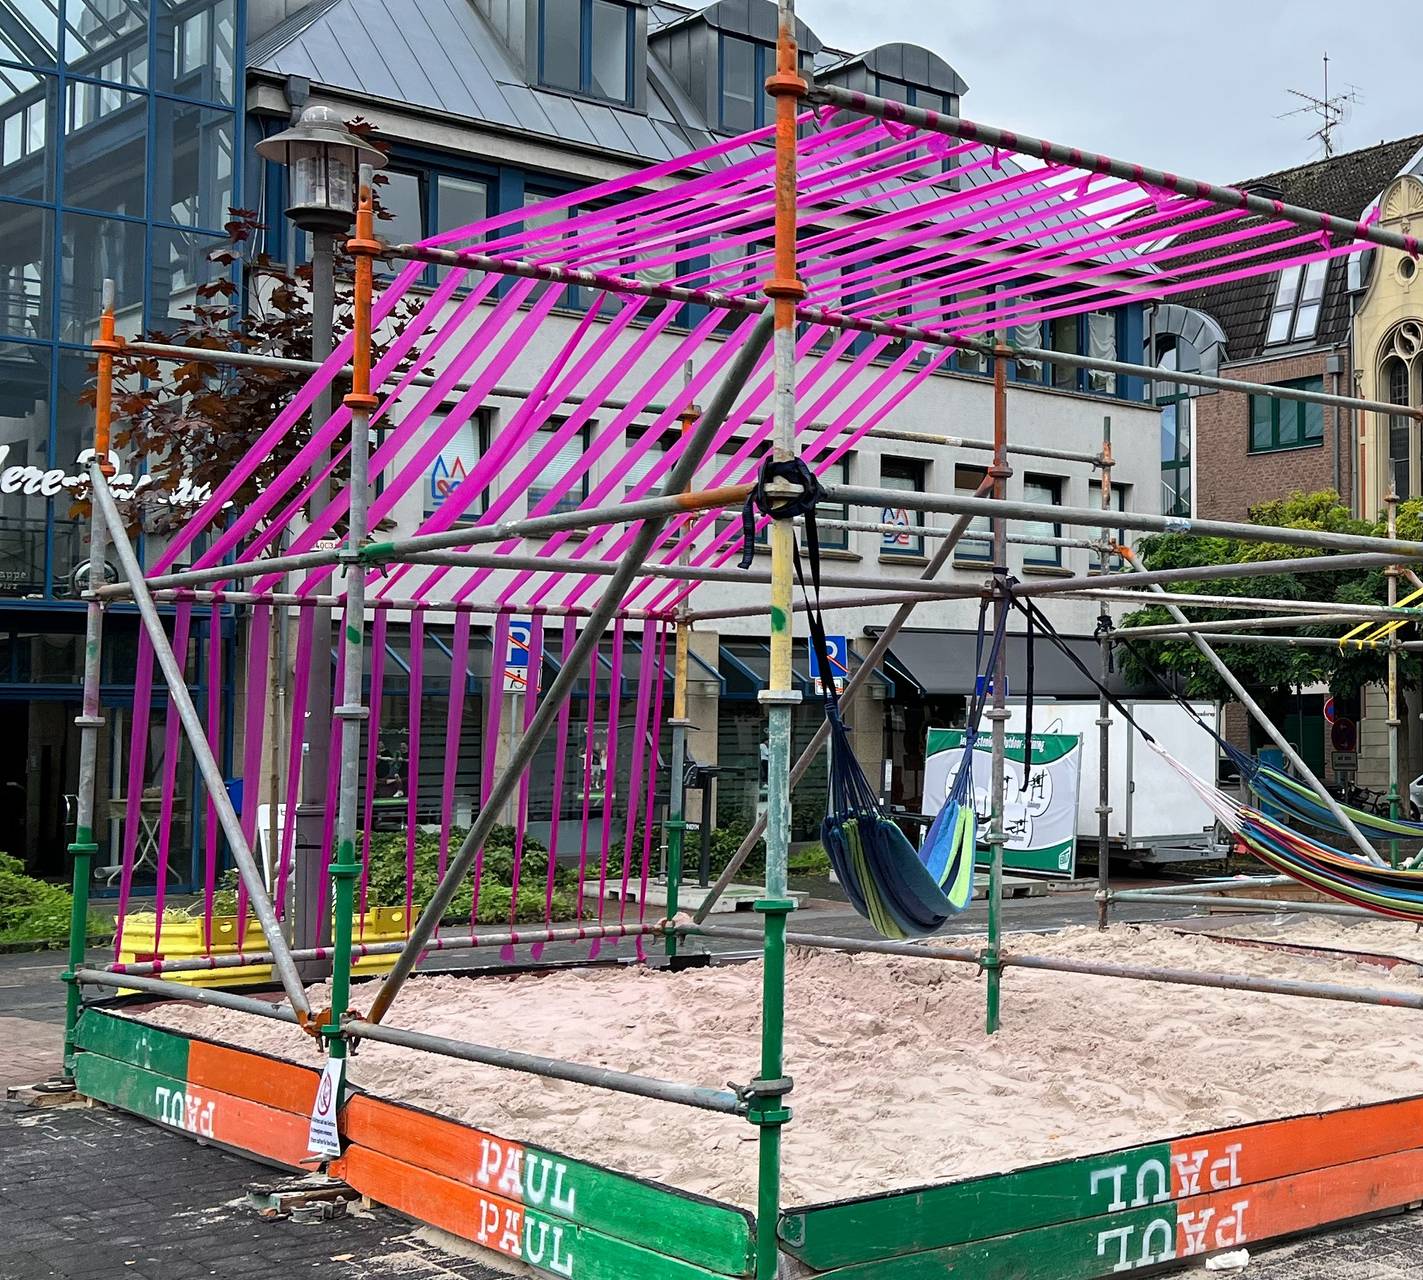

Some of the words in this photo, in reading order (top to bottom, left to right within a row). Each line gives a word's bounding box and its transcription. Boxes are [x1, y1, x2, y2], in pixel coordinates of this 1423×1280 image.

[155, 1086, 216, 1138] PAUL
[477, 1138, 576, 1214] PAUL
[1090, 1143, 1242, 1212] PAUL
[477, 1199, 573, 1278] PAUL
[1097, 1200, 1249, 1273] PAUL
